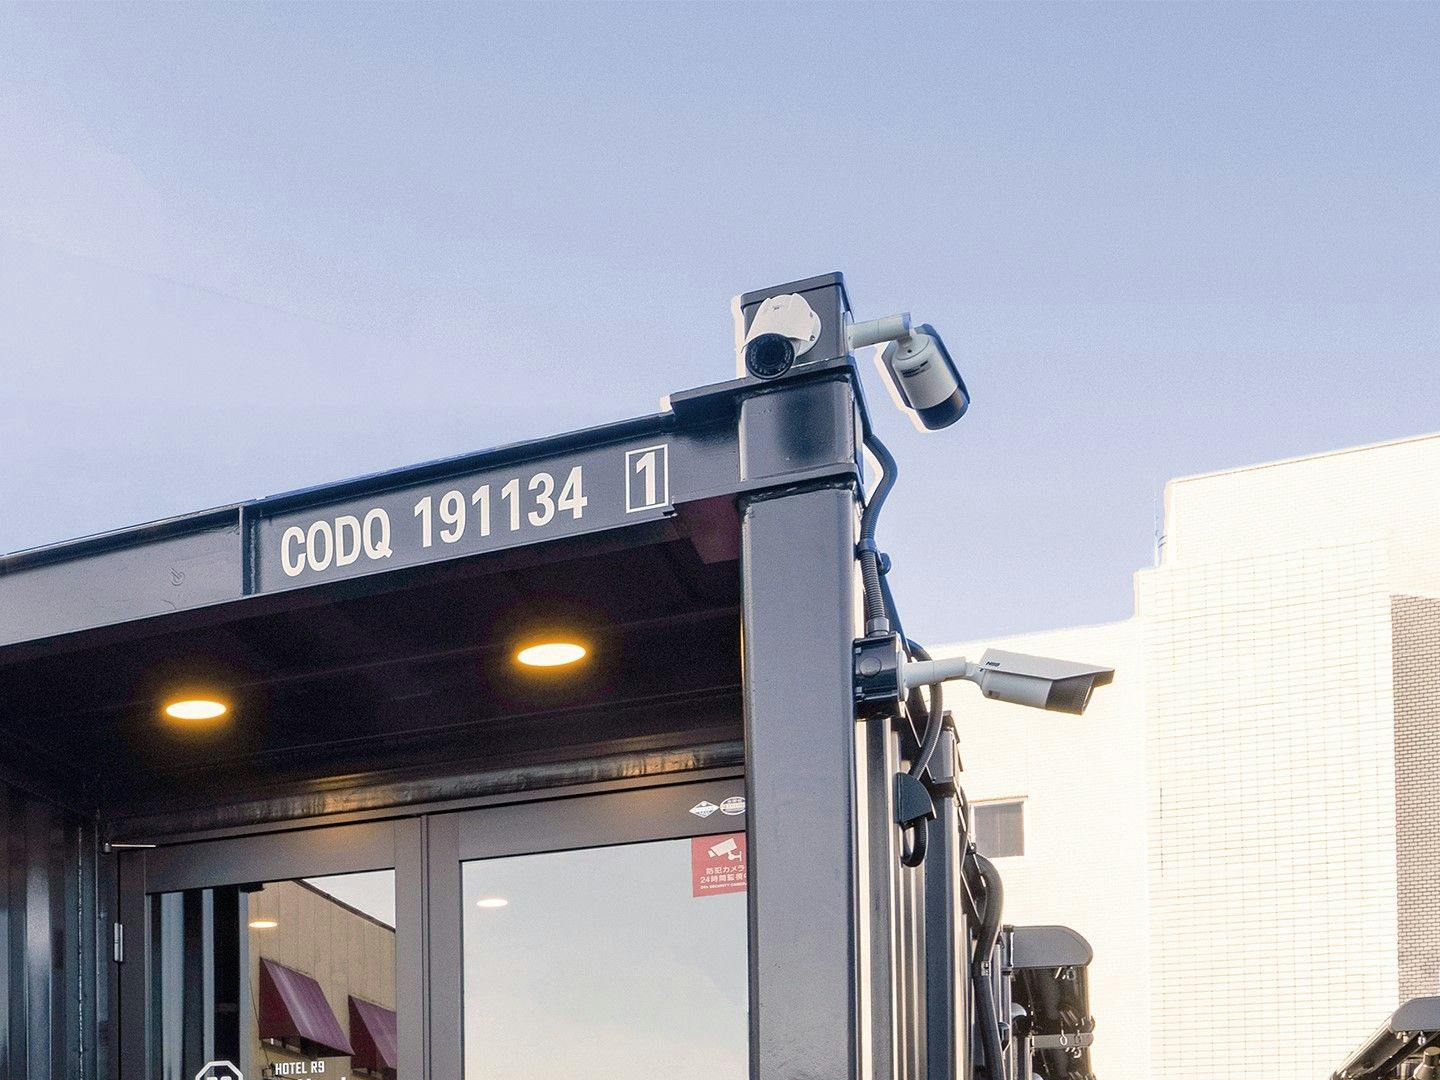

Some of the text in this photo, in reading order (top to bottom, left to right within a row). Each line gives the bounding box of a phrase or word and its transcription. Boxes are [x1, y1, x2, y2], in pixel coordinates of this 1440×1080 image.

[281, 451, 656, 577] CODQ 191134 1
[705, 864, 745, 875] 防犯カメラ
[275, 1060, 325, 1075] HOTEL R9
